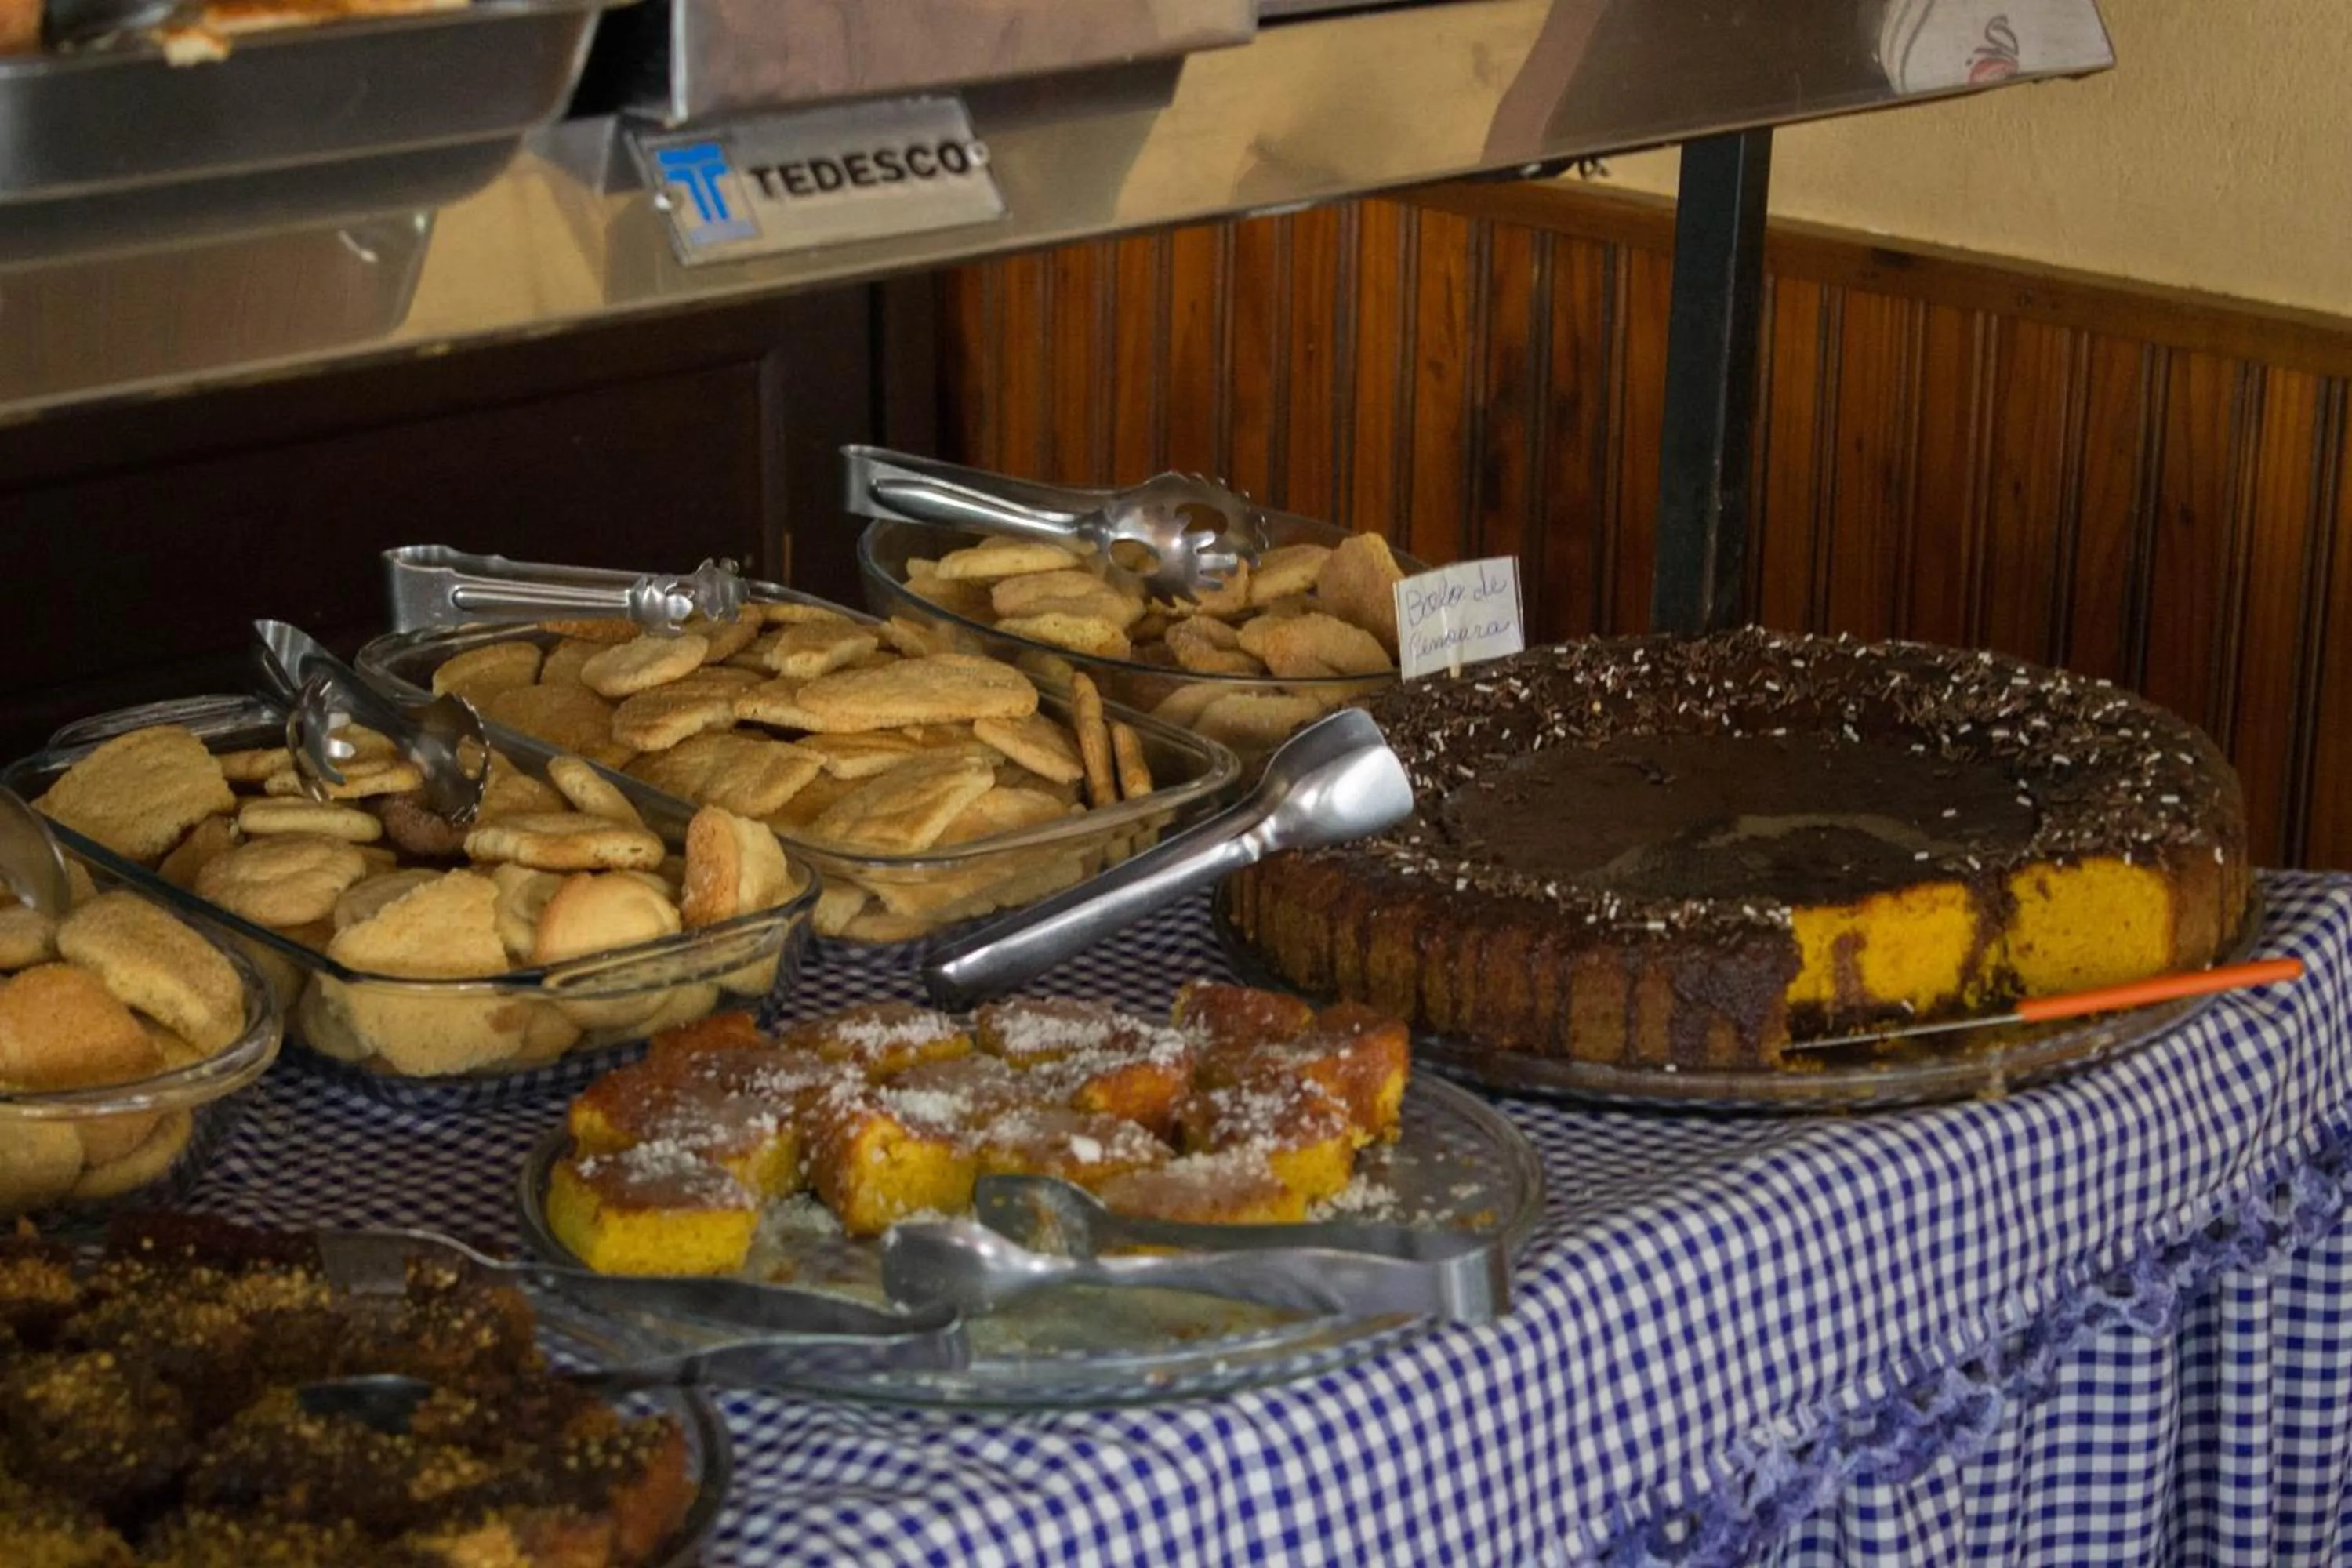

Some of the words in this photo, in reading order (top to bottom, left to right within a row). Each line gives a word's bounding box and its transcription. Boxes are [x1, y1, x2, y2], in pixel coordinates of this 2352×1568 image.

[750, 140, 971, 198] TEDESCO
[1406, 575, 1465, 627] Bolo
[1472, 564, 1508, 602] de
